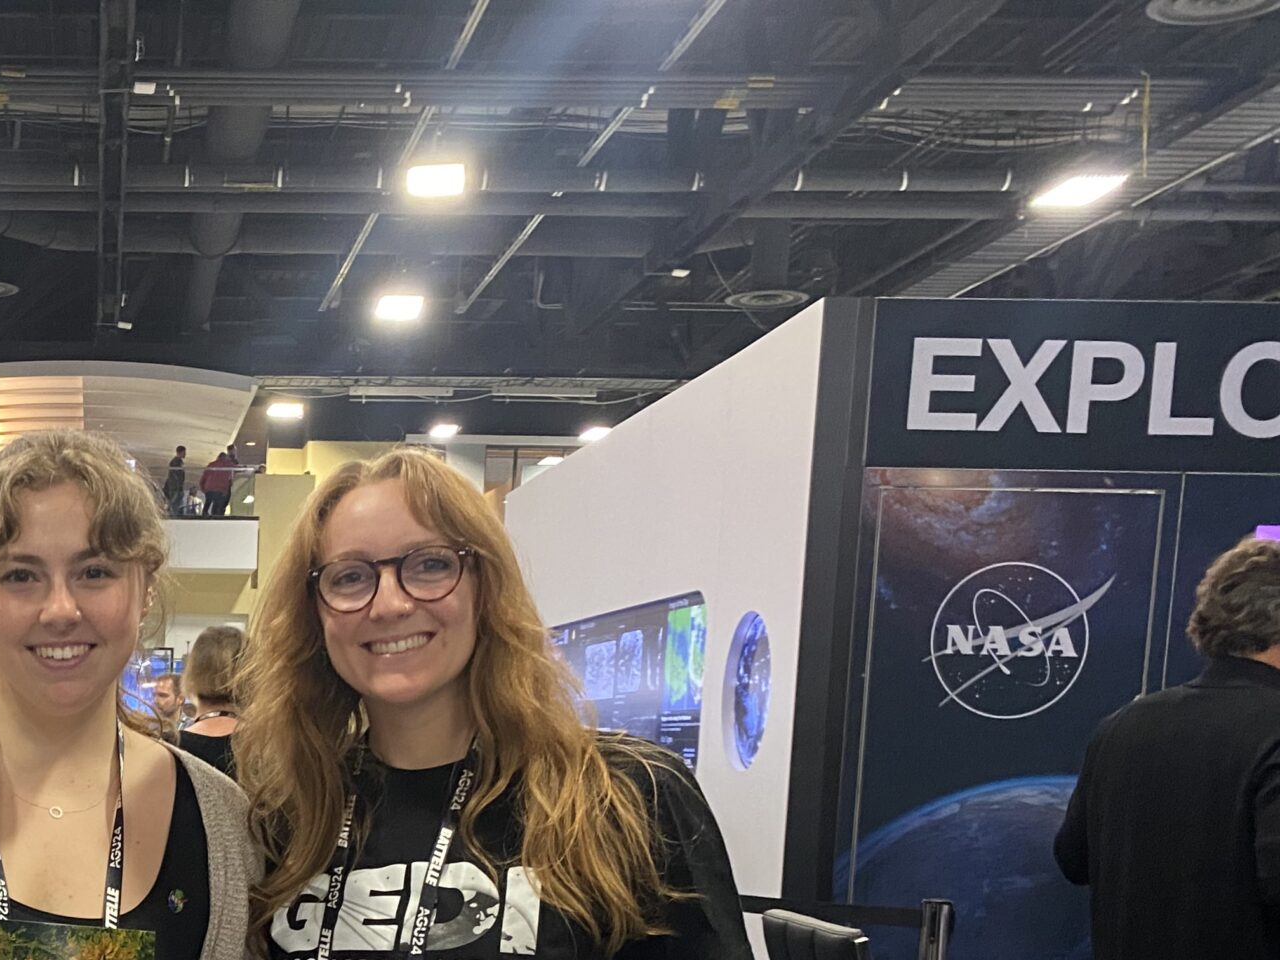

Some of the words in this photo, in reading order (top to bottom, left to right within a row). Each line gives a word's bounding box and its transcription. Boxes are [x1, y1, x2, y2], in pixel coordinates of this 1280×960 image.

[946, 624, 1078, 658] NASA
[450, 769, 474, 811] AGU24
[338, 795, 357, 848] BATTELLE
[110, 826, 122, 868] AGU24
[425, 827, 453, 887] BATTELLE
[271, 861, 541, 955] GEDI
[327, 866, 344, 909] AGU24
[411, 906, 431, 956] AGU24
